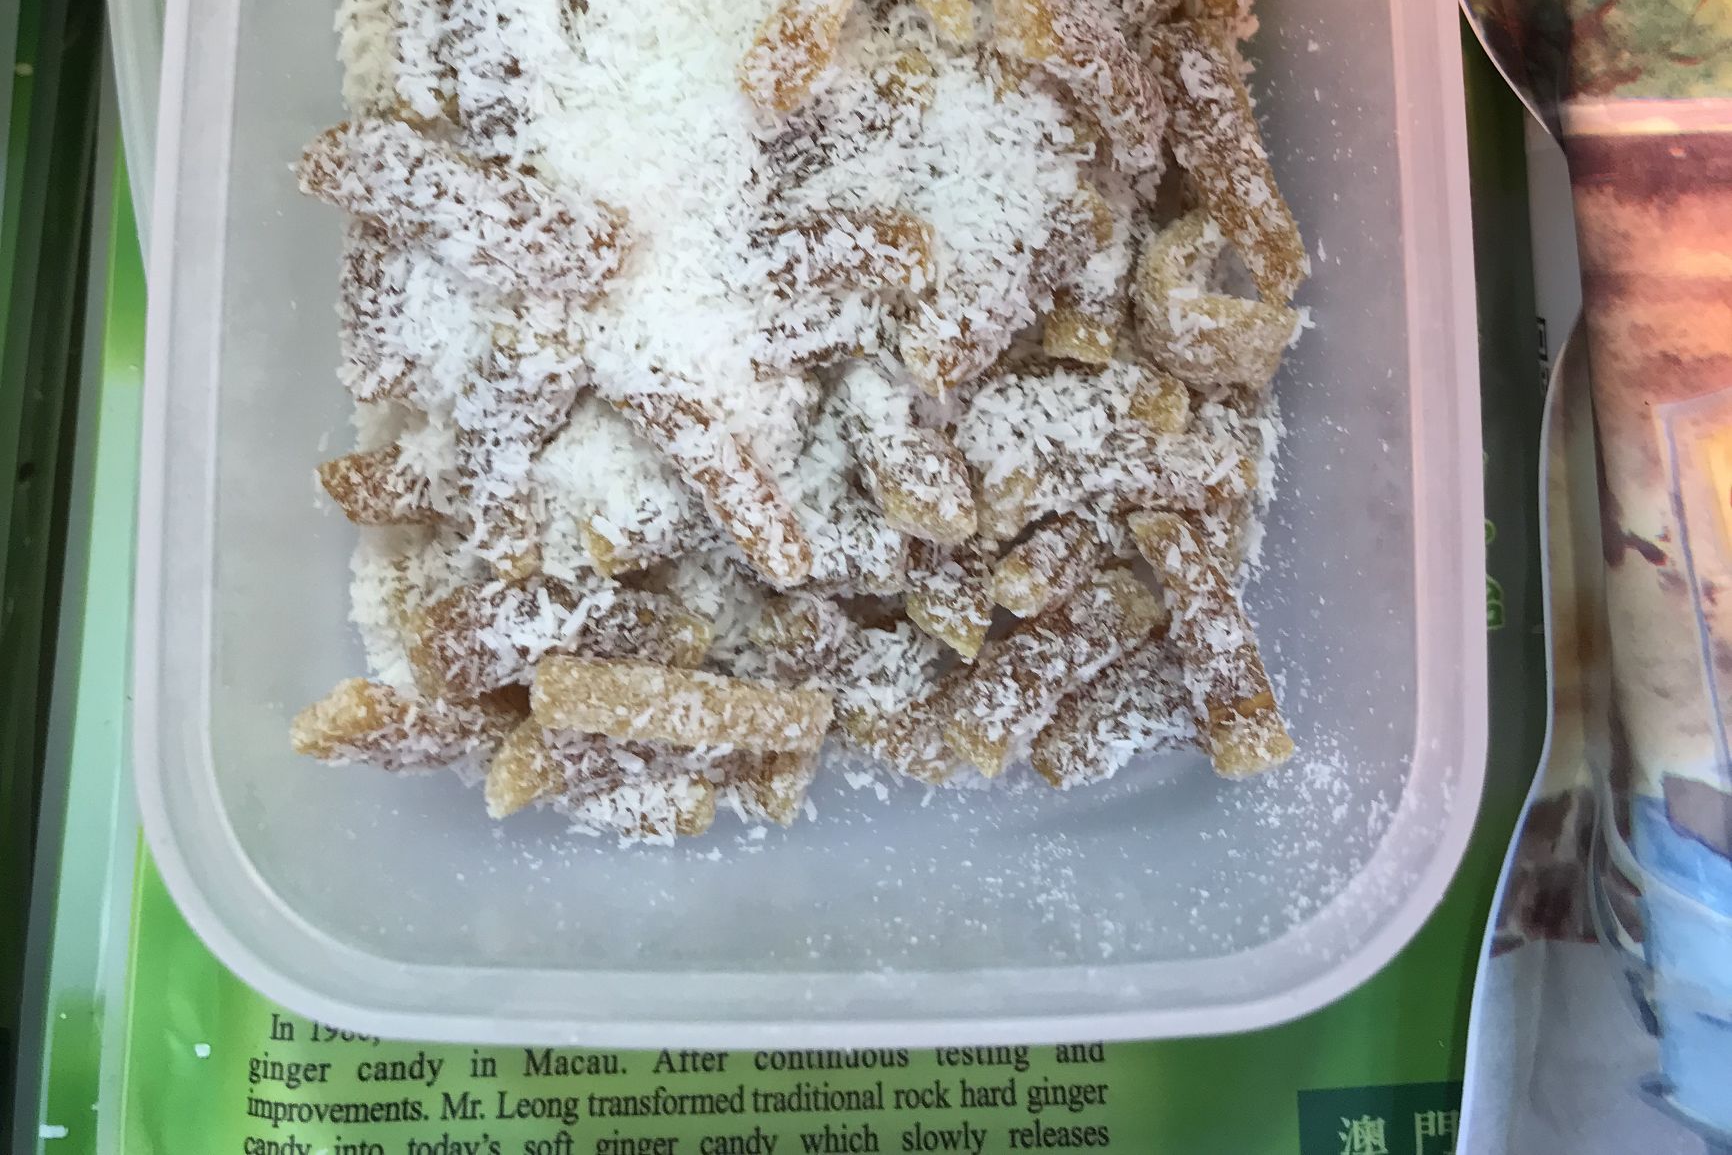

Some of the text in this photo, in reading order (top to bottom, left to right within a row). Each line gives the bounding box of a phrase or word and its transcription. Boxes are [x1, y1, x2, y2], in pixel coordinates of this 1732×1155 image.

[270, 1013, 295, 1041] In
[248, 1040, 1105, 1089] ginger candy in Macau. After continuous testing and
[246, 1077, 1109, 1128] improvements. Mr. Leong transformed traditional rock hard ginger
[334, 1135, 384, 1155] into
[523, 1130, 575, 1155] soft
[596, 1130, 679, 1155] ginger
[699, 1126, 778, 1155] candy
[800, 1124, 879, 1154] which
[902, 1122, 987, 1154] slowly
[1008, 1119, 1111, 1150] releases
